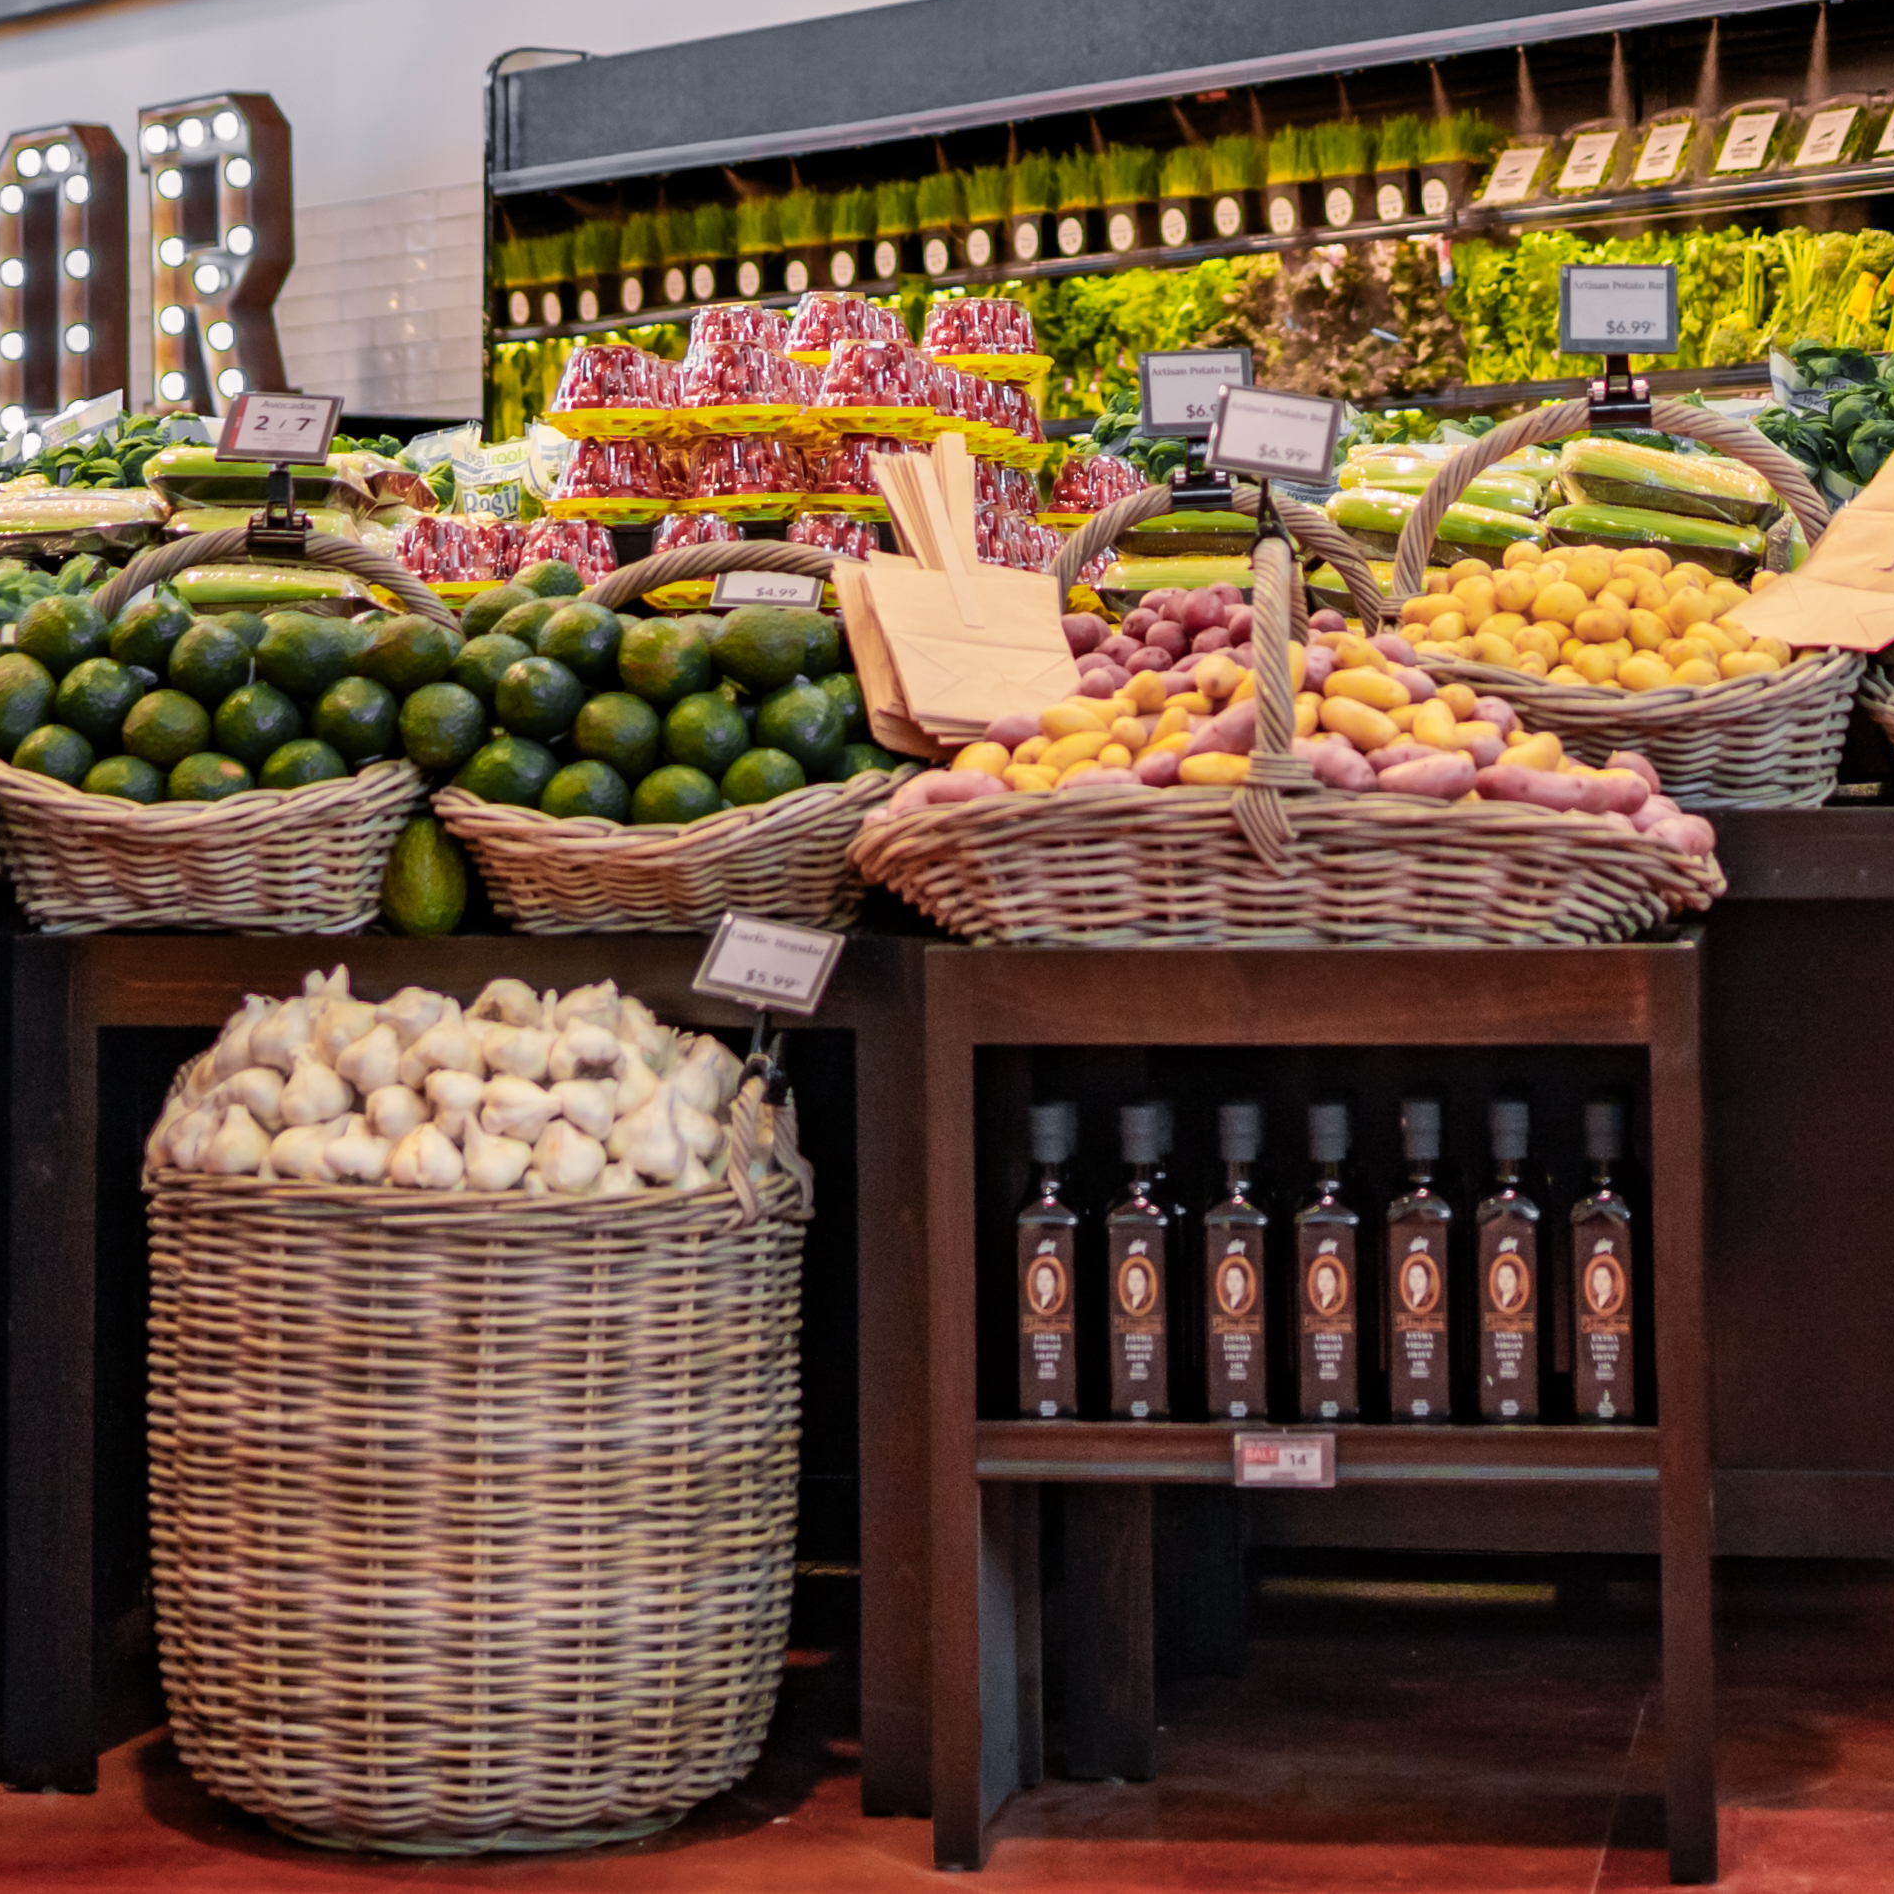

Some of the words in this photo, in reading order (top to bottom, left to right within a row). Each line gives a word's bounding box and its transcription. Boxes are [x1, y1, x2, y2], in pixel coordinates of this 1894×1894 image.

[1648, 281, 1665, 290] Bar
[1606, 319, 1651, 335] $6.99
[1151, 366, 1187, 377] Artisan
[1190, 366, 1222, 375] Potato
[1224, 364, 1240, 374] Bar
[260, 400, 317, 411] Avocados
[1186, 403, 1218, 419] $6.9
[254, 415, 269, 431] 2
[1258, 443, 1306, 462] $6.99
[464, 485, 519, 517] Basil
[756, 586, 798, 598] $4.99
